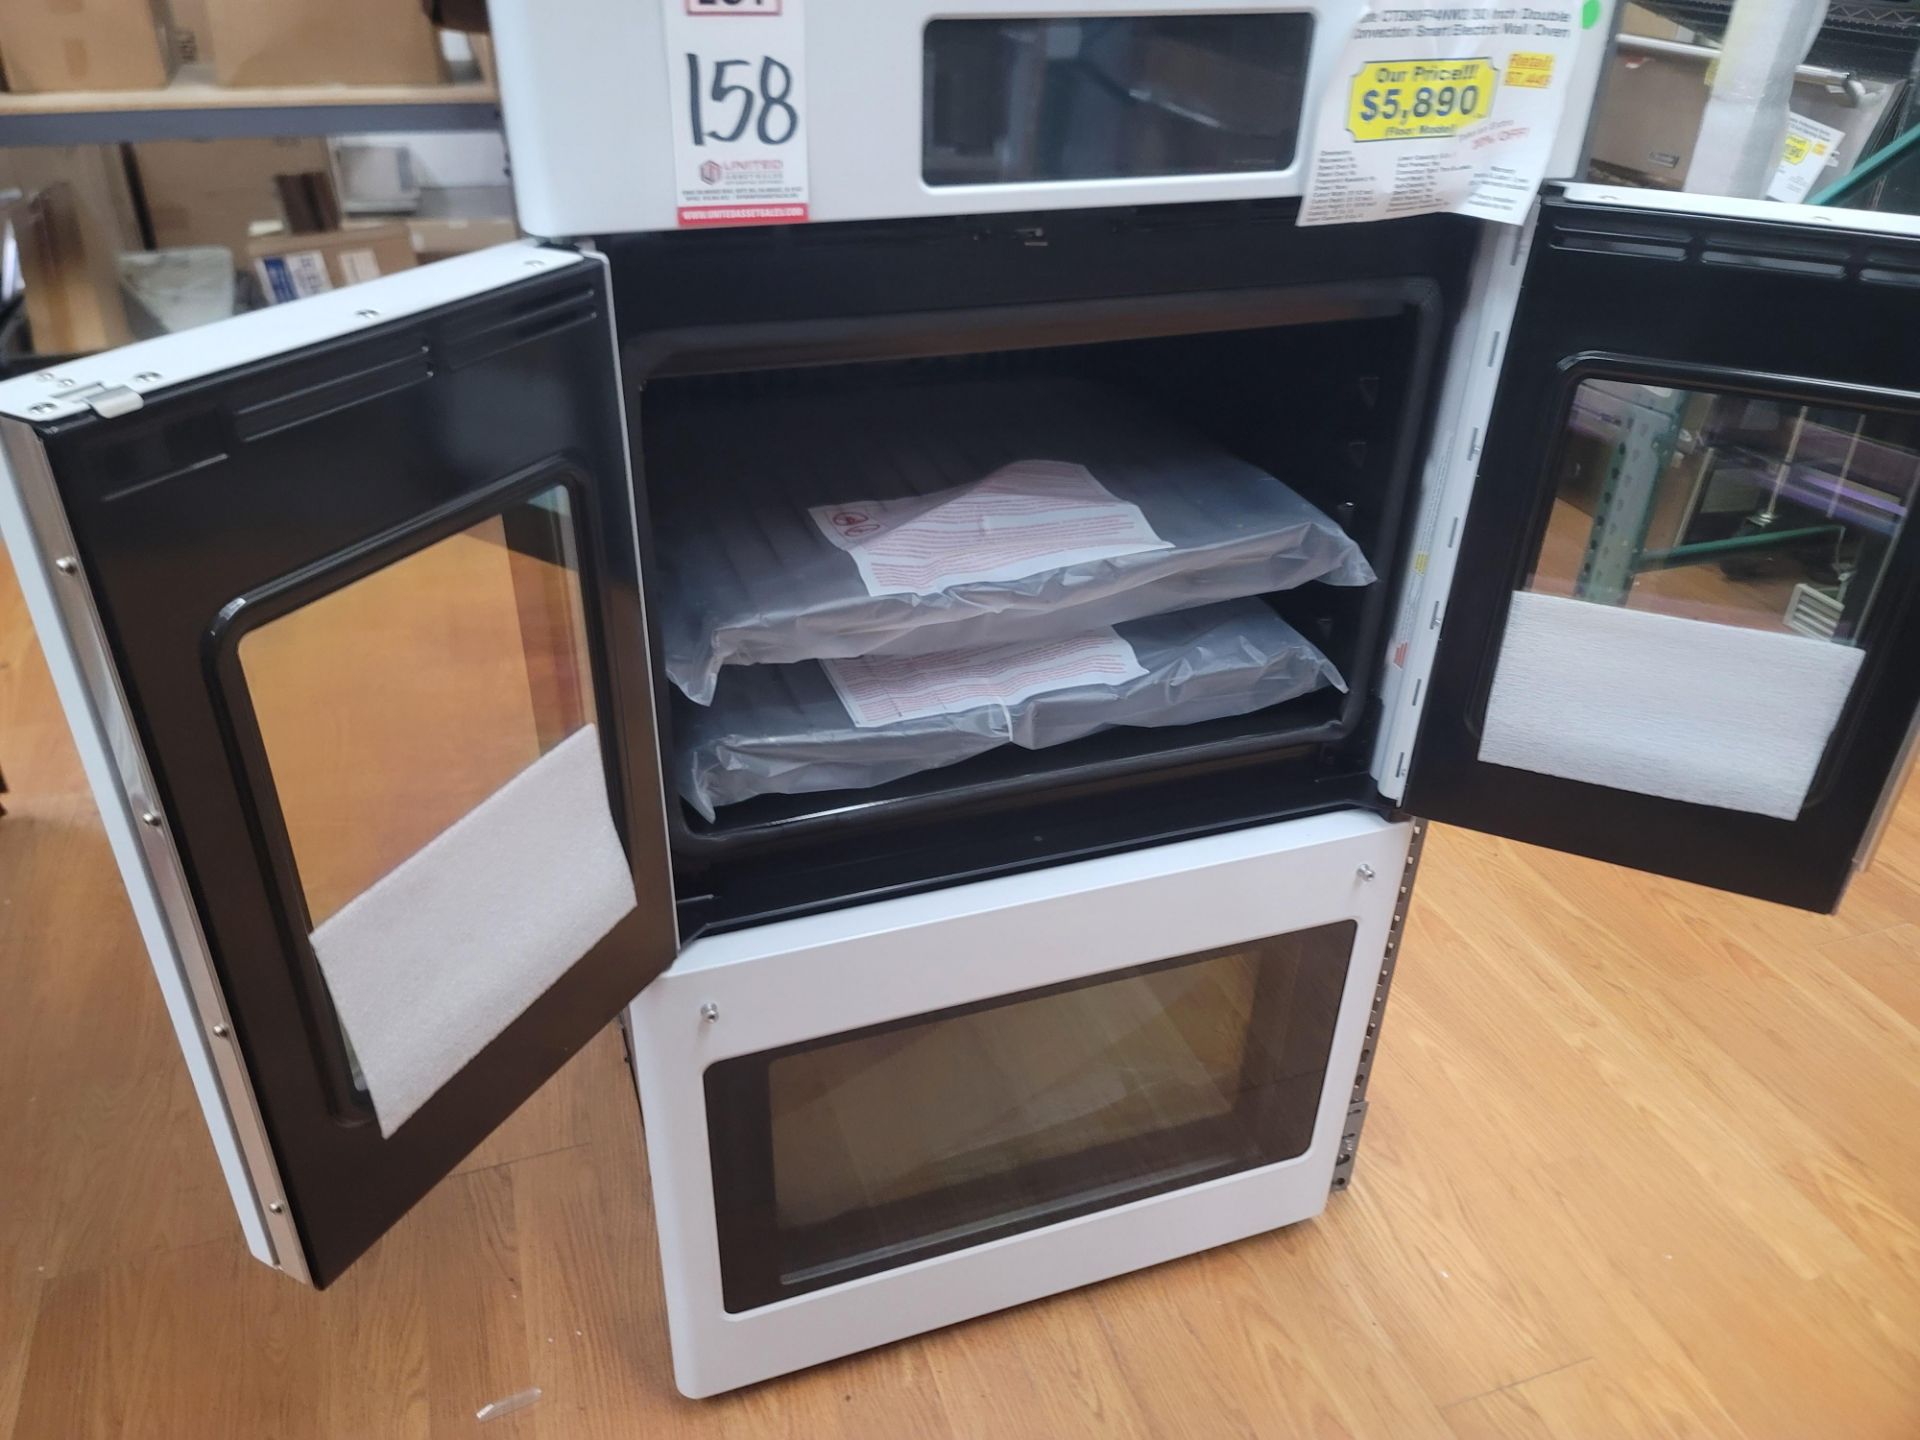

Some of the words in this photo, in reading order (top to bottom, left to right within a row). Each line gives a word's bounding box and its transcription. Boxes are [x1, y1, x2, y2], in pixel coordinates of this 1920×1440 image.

[1521, 8, 1571, 22] Double
[1416, 25, 1449, 37] Smart
[1452, 24, 1499, 36] Electric
[1504, 23, 1528, 35] Wall
[1535, 24, 1570, 38] Oven
[1376, 67, 1407, 84] Our
[1413, 64, 1480, 82] Price!!!
[686, 53, 798, 146] 158
[1360, 85, 1479, 124] $5,890
